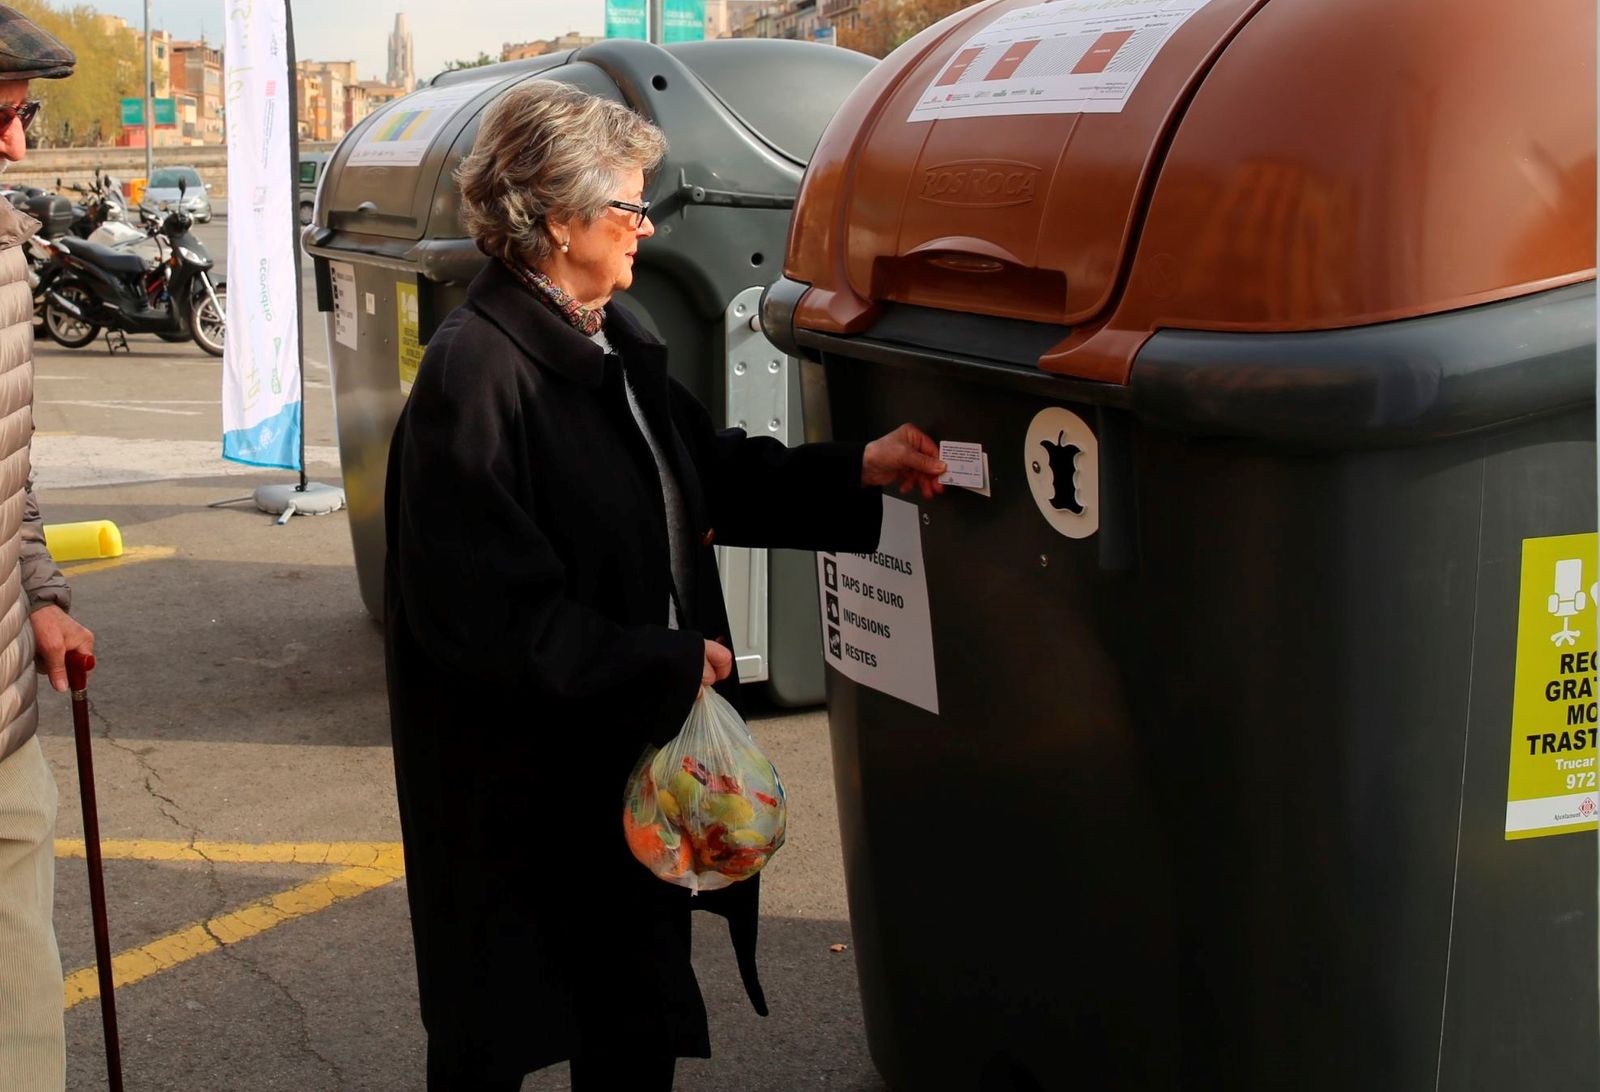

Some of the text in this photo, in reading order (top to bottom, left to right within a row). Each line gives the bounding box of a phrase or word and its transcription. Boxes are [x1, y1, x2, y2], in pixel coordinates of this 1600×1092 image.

[868, 551, 913, 576] VEGETALS
[841, 573, 905, 609] TAPS DE SURO
[843, 607, 891, 639] INFUSIONS
[845, 642, 877, 668] RESTES
[1545, 676, 1598, 702] GRA
[1555, 758, 1596, 771] Trucar
[1566, 771, 1597, 790] 972
